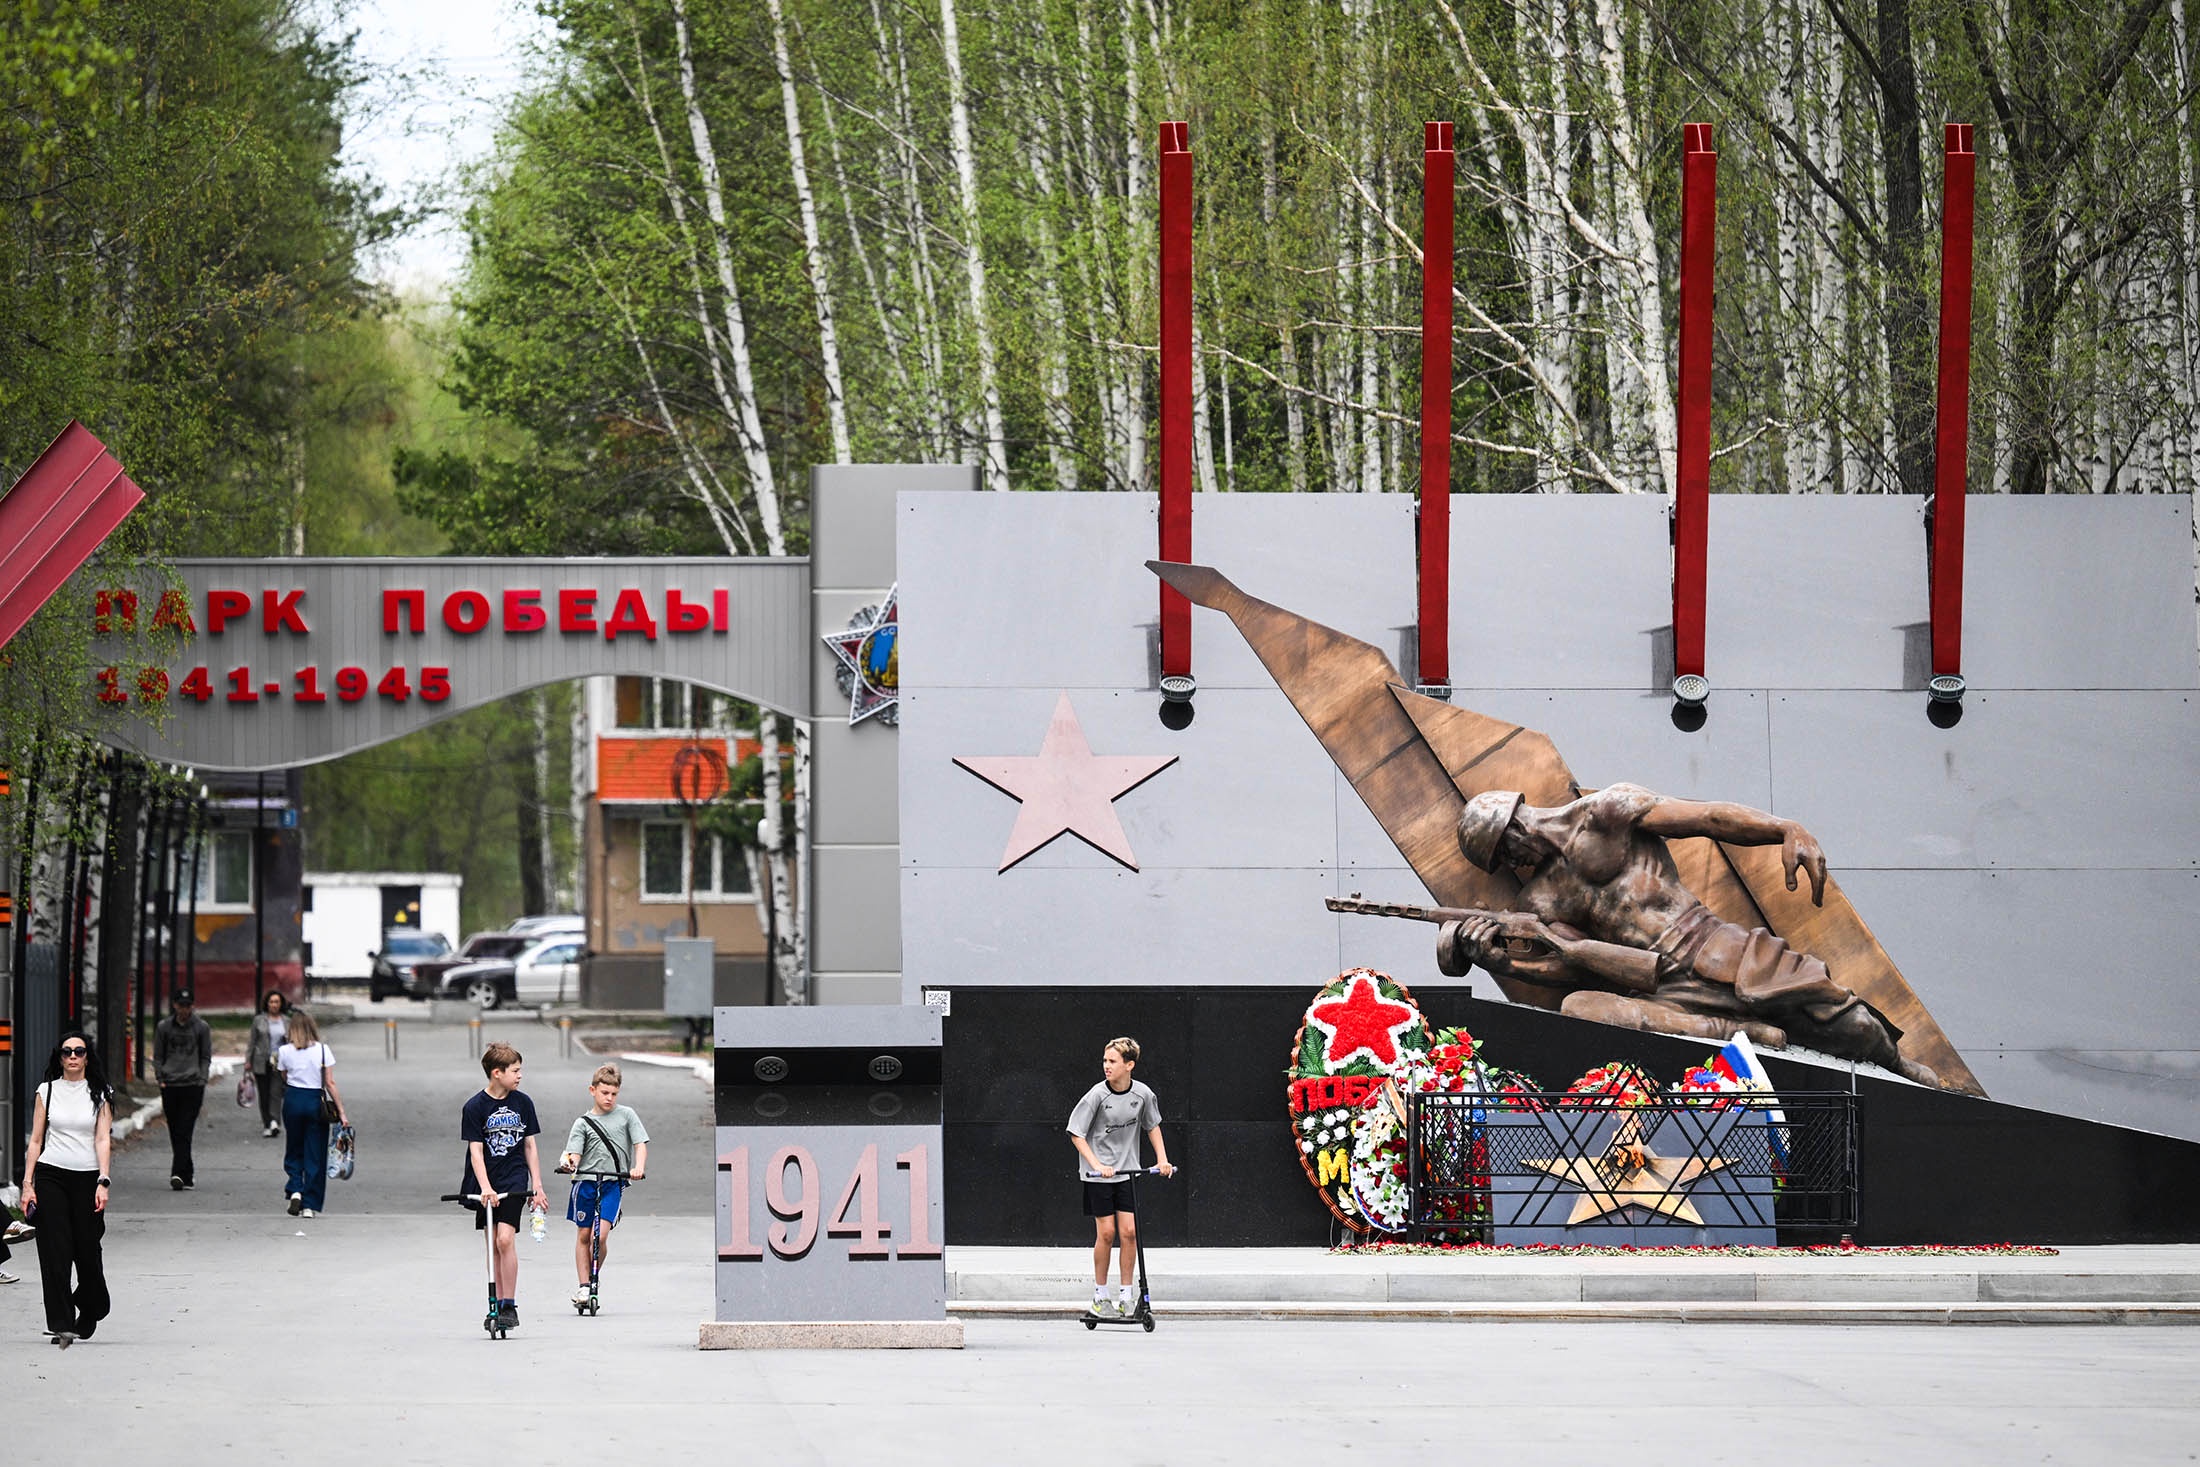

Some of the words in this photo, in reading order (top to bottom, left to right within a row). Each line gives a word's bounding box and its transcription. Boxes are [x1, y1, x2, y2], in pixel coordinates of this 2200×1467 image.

[95, 589, 309, 633] ПАРК
[382, 589, 729, 641] ПОБЕДЫ
[96, 666, 451, 702] 1941-1945
[717, 1143, 942, 1260] 1941
